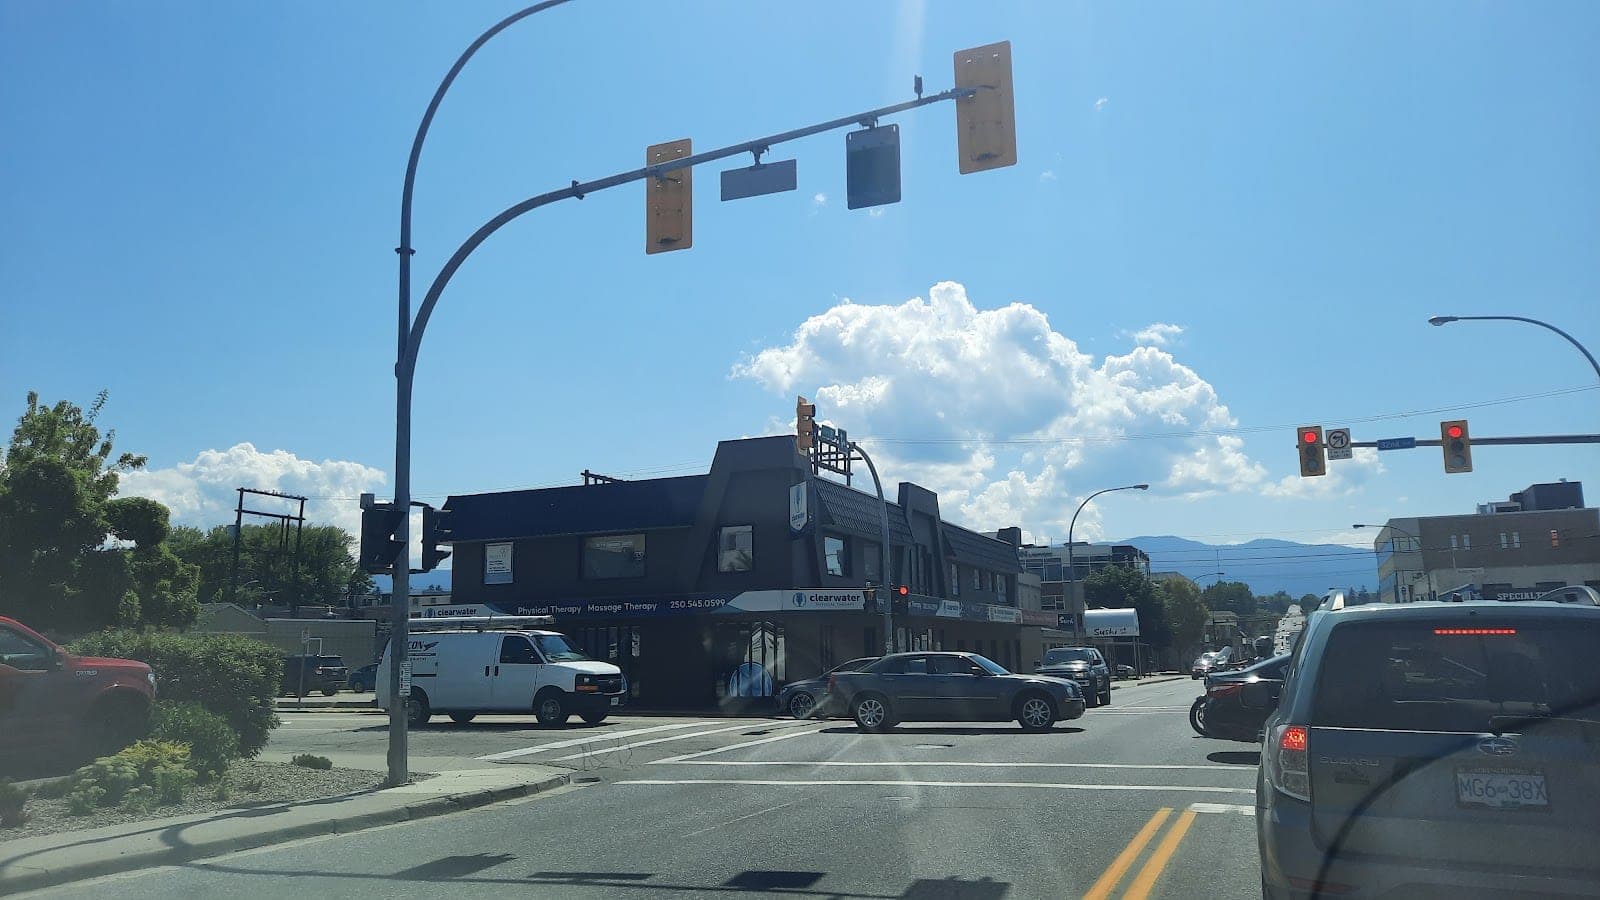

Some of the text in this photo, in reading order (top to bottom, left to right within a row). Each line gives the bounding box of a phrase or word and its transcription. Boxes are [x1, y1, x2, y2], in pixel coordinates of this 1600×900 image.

[809, 593, 861, 602] clearwater
[437, 607, 478, 617] clearwater
[517, 599, 726, 616] Physical Therapy Massage Therapy 250.545.0599
